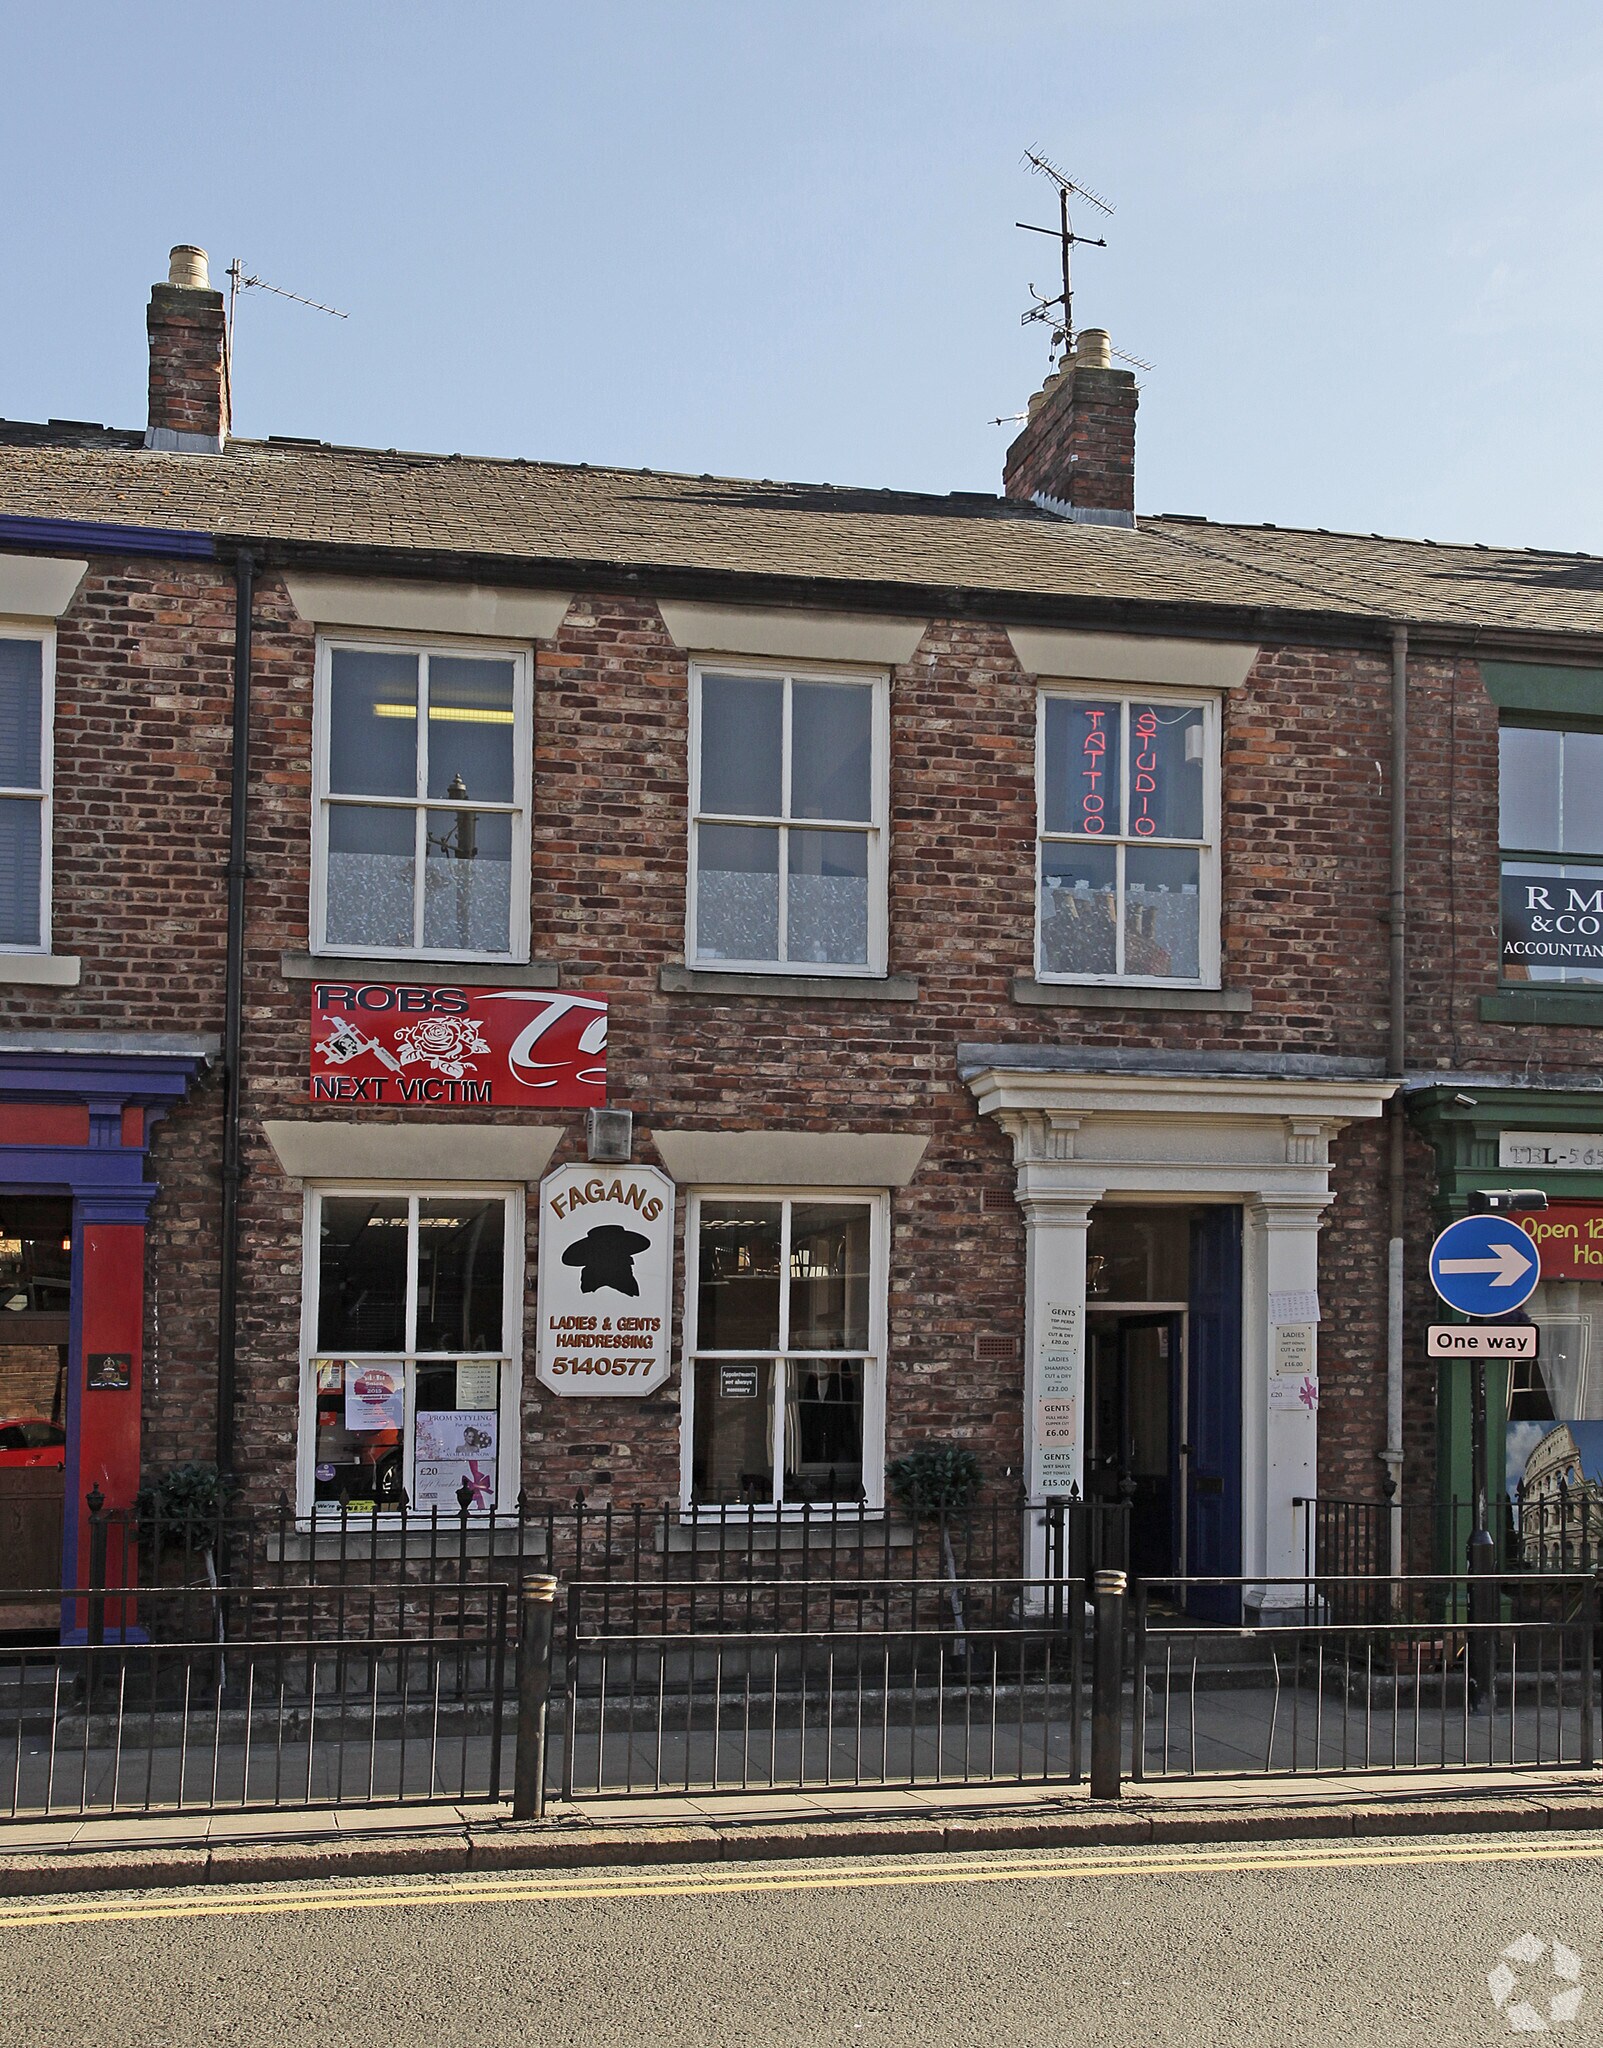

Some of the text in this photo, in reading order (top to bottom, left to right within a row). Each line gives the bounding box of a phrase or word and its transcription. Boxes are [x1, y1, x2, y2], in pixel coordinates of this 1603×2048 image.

[1083, 711, 1106, 835] TATTOO
[1135, 713, 1157, 836] STUDIO
[1525, 886, 1555, 910] R
[1503, 941, 1603, 957] ACCOUNTAN
[314, 984, 471, 1014] ROBS
[313, 1075, 493, 1103] NEXT VICTIM
[549, 1179, 664, 1222] FAGANS
[1521, 1217, 1579, 1244] Open
[549, 1315, 661, 1332] LADIES & GENTS
[1051, 1308, 1076, 1317] GENTS
[556, 1334, 653, 1349] HAIRDRESSING
[1436, 1333, 1528, 1352] One way
[552, 1356, 656, 1377] 5140577
[420, 1468, 438, 1476] £20
